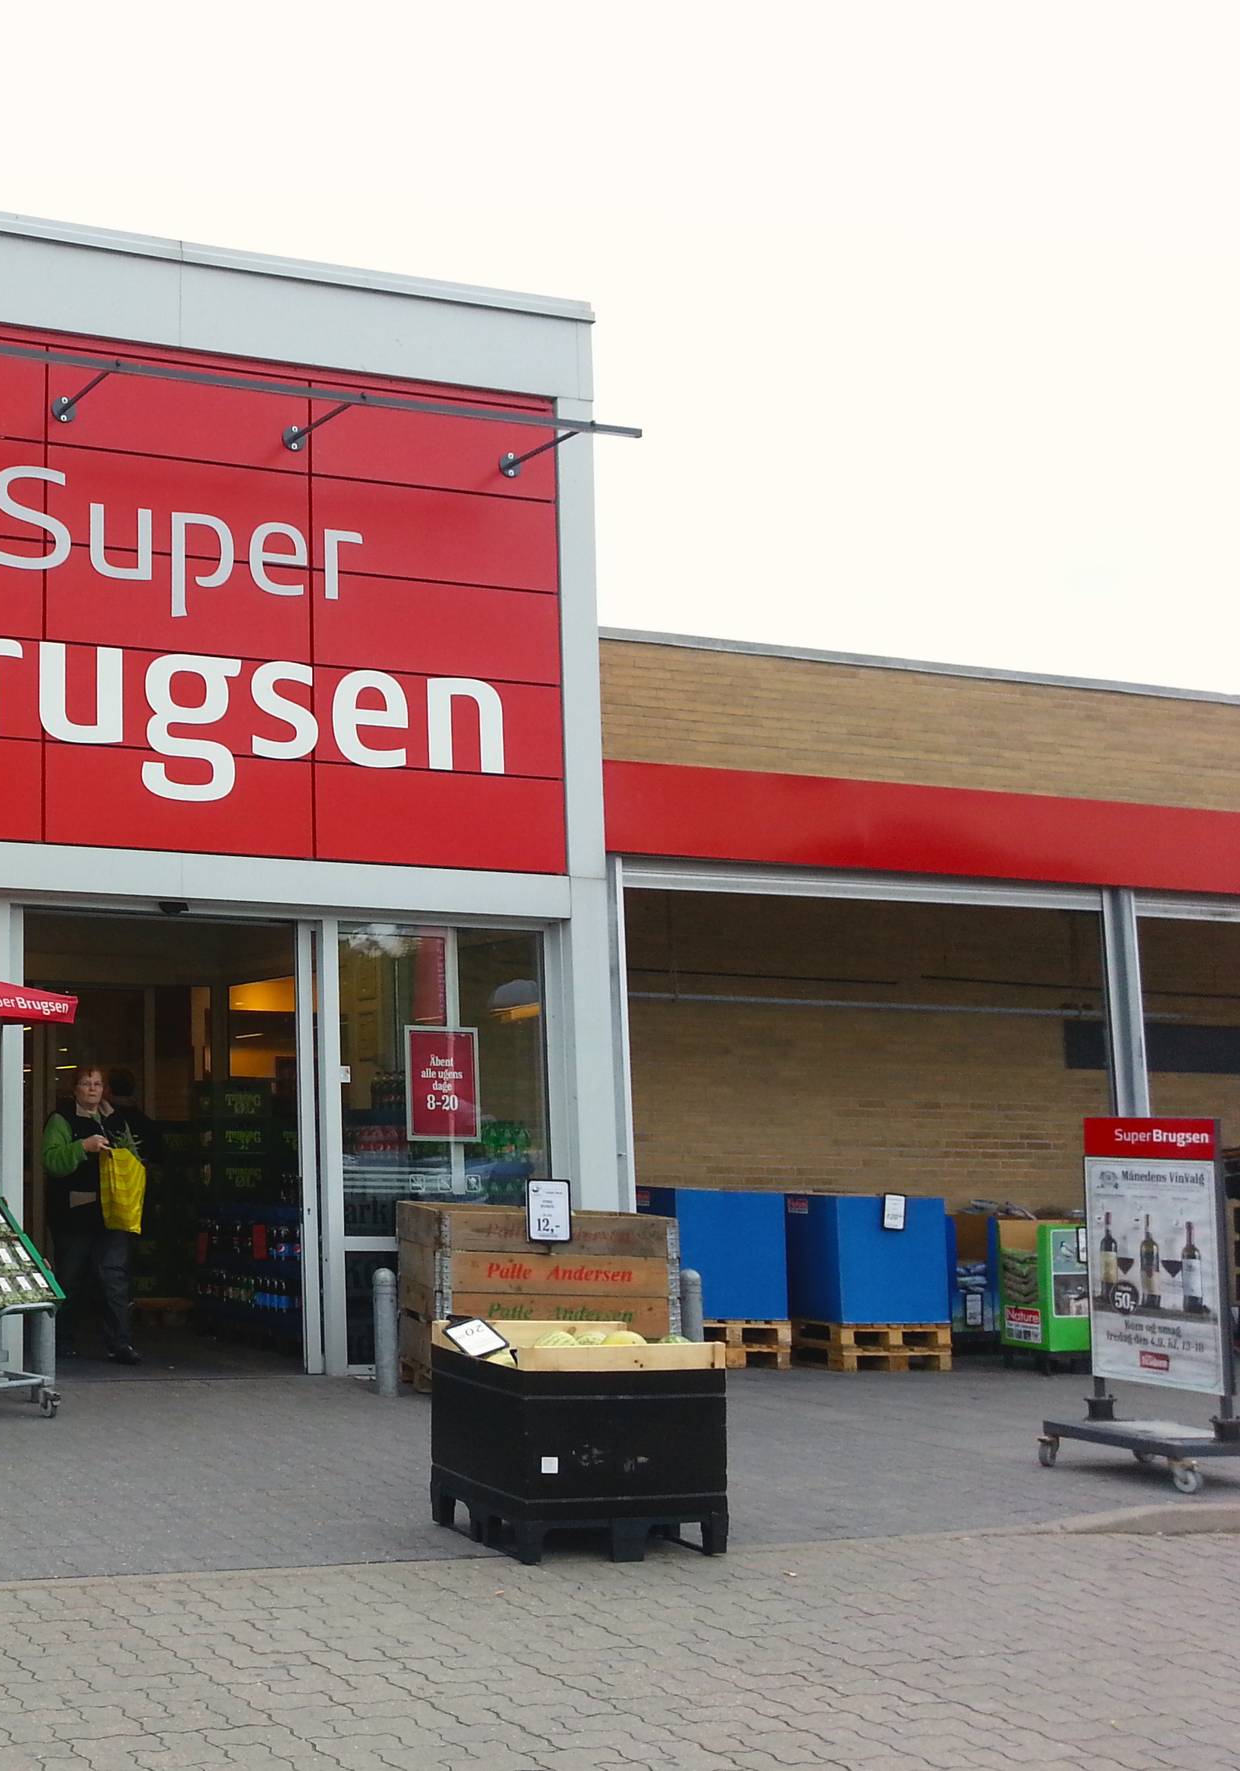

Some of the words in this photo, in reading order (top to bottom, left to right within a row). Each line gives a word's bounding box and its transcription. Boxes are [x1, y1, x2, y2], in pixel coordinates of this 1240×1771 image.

[430, 1054, 454, 1067] Åbent
[421, 1068, 436, 1079] alle
[438, 1069, 463, 1081] ugens
[432, 1081, 452, 1093] dage
[427, 1094, 458, 1111] 8-20
[1114, 1129, 1210, 1147] SuperBrugsen
[1121, 1170, 1167, 1183] Månedens
[487, 1262, 532, 1280] Palle
[546, 1264, 633, 1282] Andersen
[488, 1302, 534, 1319] Palle
[552, 1305, 634, 1322] Andersen
[1007, 1308, 1040, 1323] Nature
